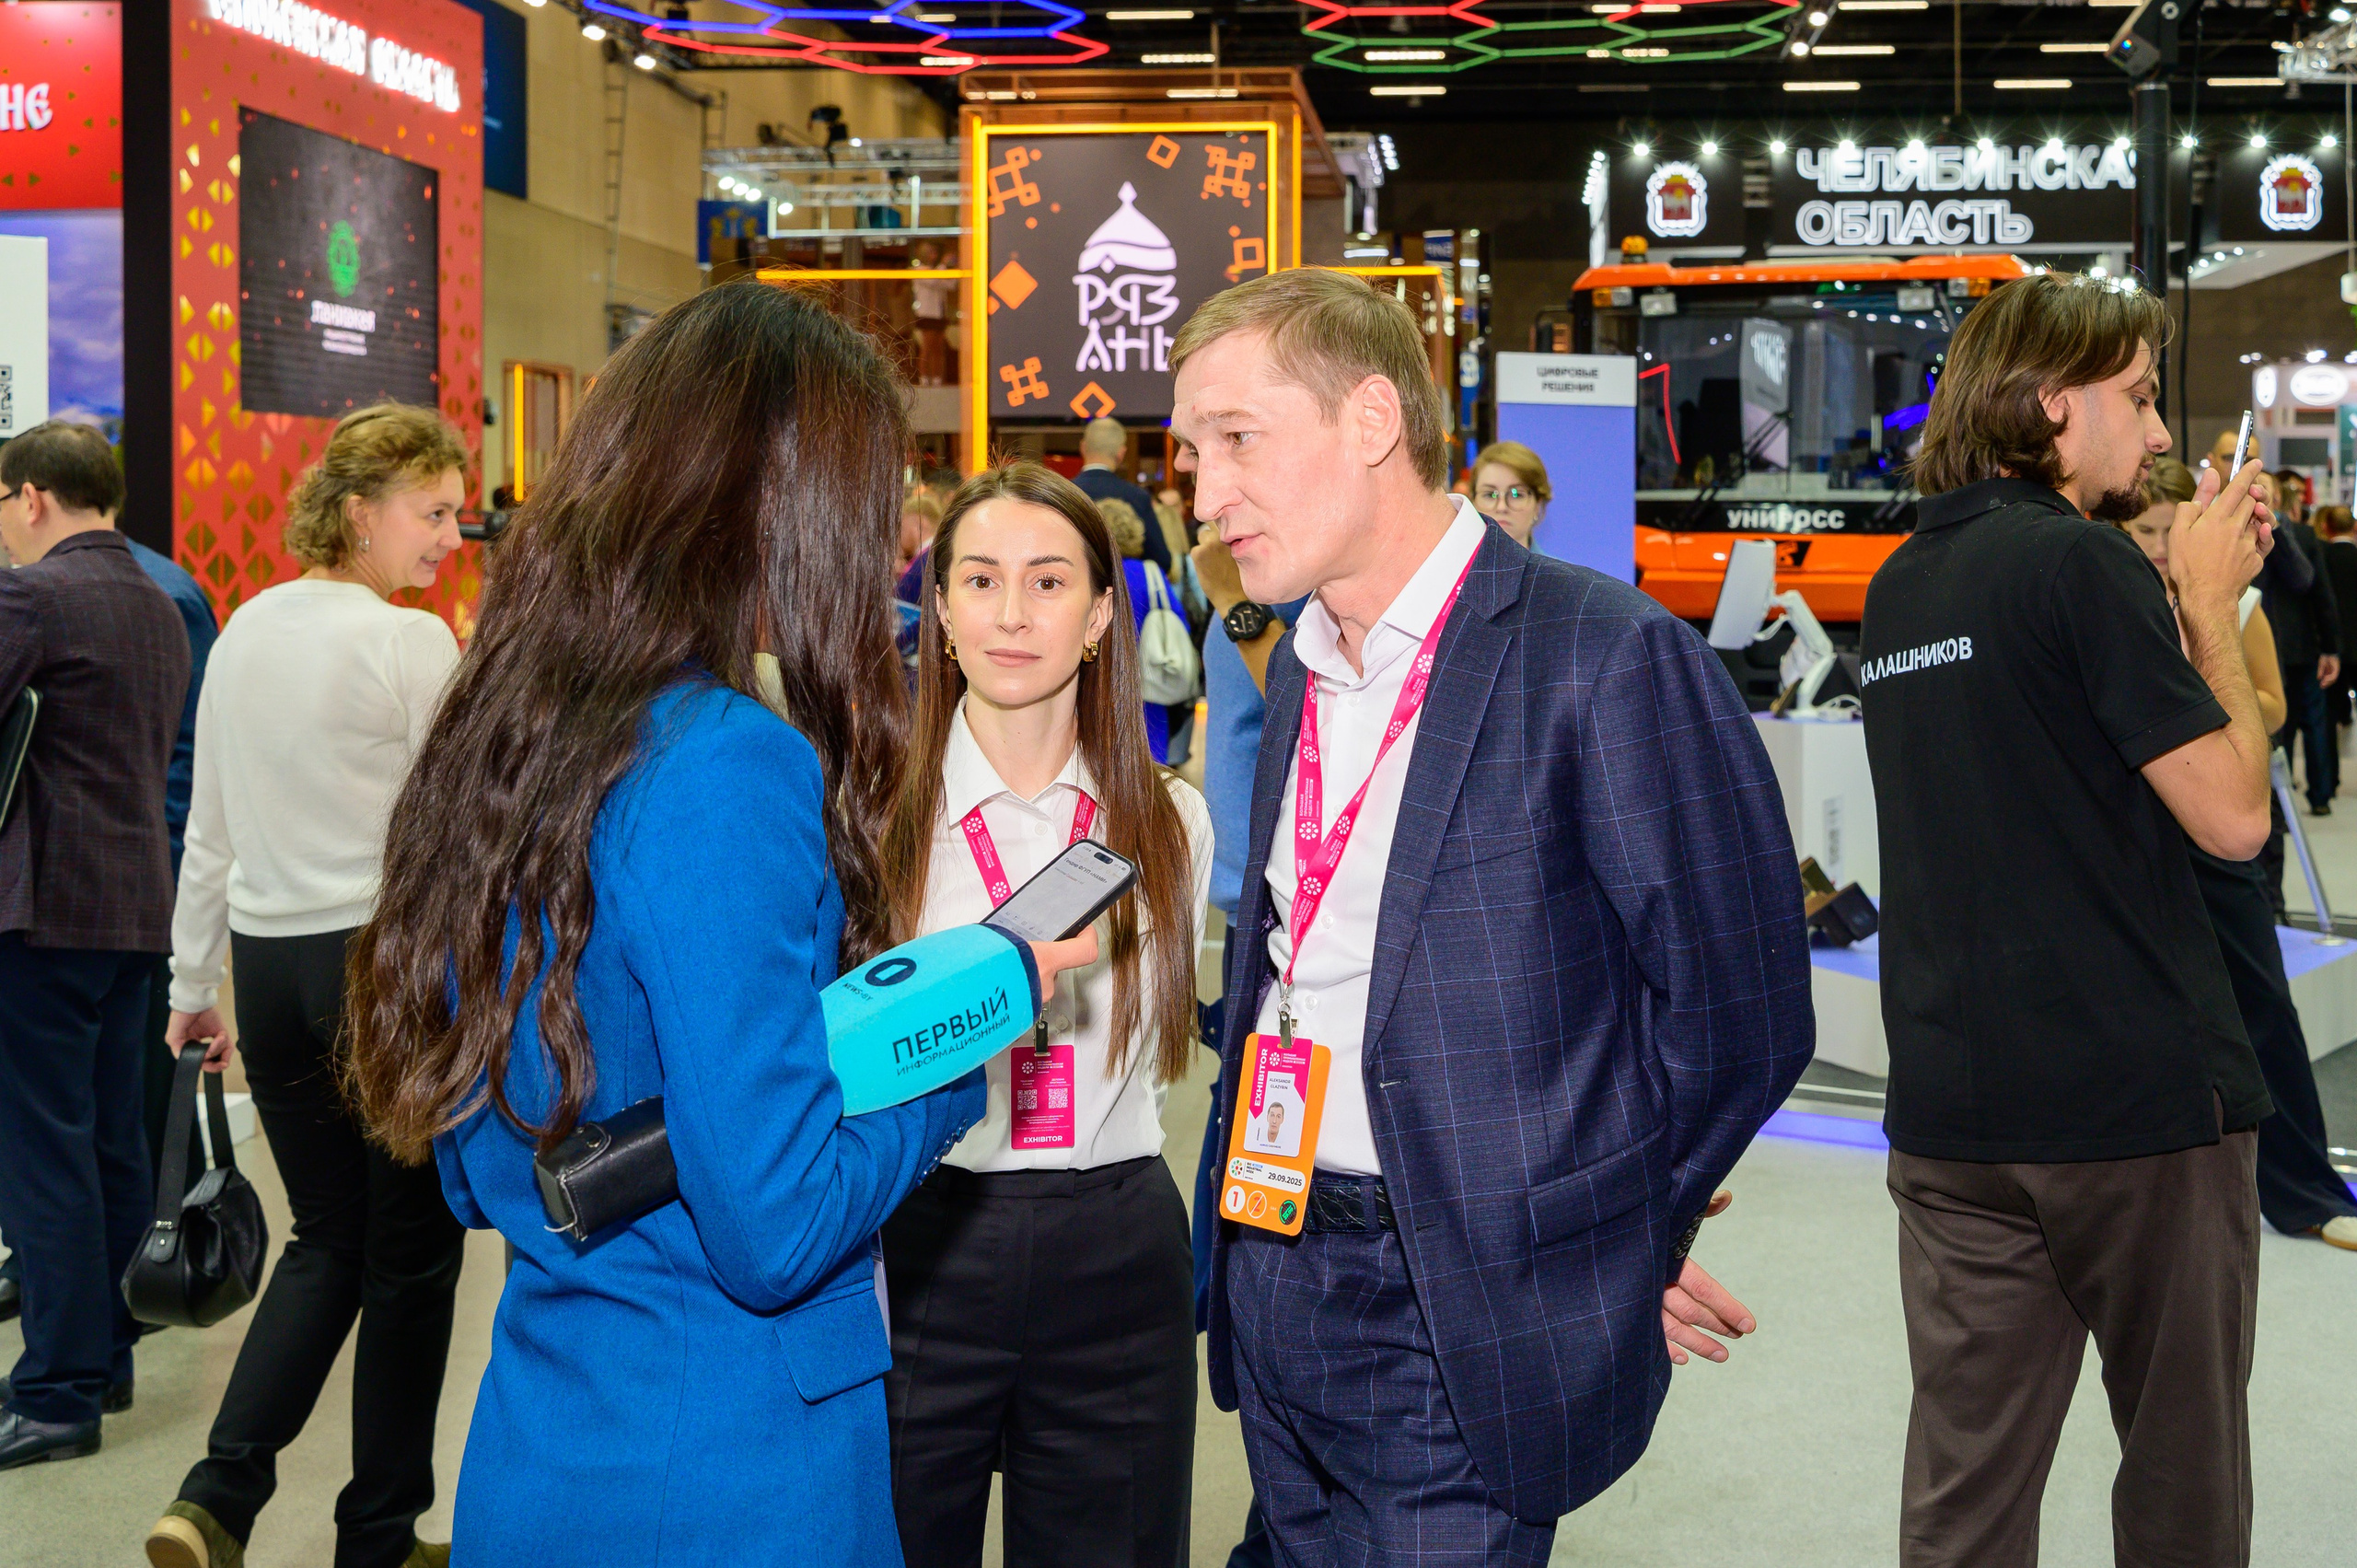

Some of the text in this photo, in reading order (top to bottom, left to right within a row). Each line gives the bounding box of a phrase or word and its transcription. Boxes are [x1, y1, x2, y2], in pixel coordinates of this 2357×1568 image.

[1795, 145, 2136, 192] ЧЕЛЯБИНСКА
[1795, 199, 2035, 246] ОБЛАСТЬ
[1537, 366, 1600, 379] ЦИФРОВЫЕ
[1860, 636, 1973, 687] КАЛАШНИКОВ
[892, 986, 1008, 1063] ПЕРВЫЙ
[897, 1014, 1011, 1076] ИНФОРМАЦИОННЫЙ
[1254, 1048, 1269, 1107] EXHIBITOR
[1023, 1135, 1063, 1144] EXHIBITOR
[1233, 1191, 1239, 1208] 1
[1267, 1171, 1303, 1188] 29.09.2025
